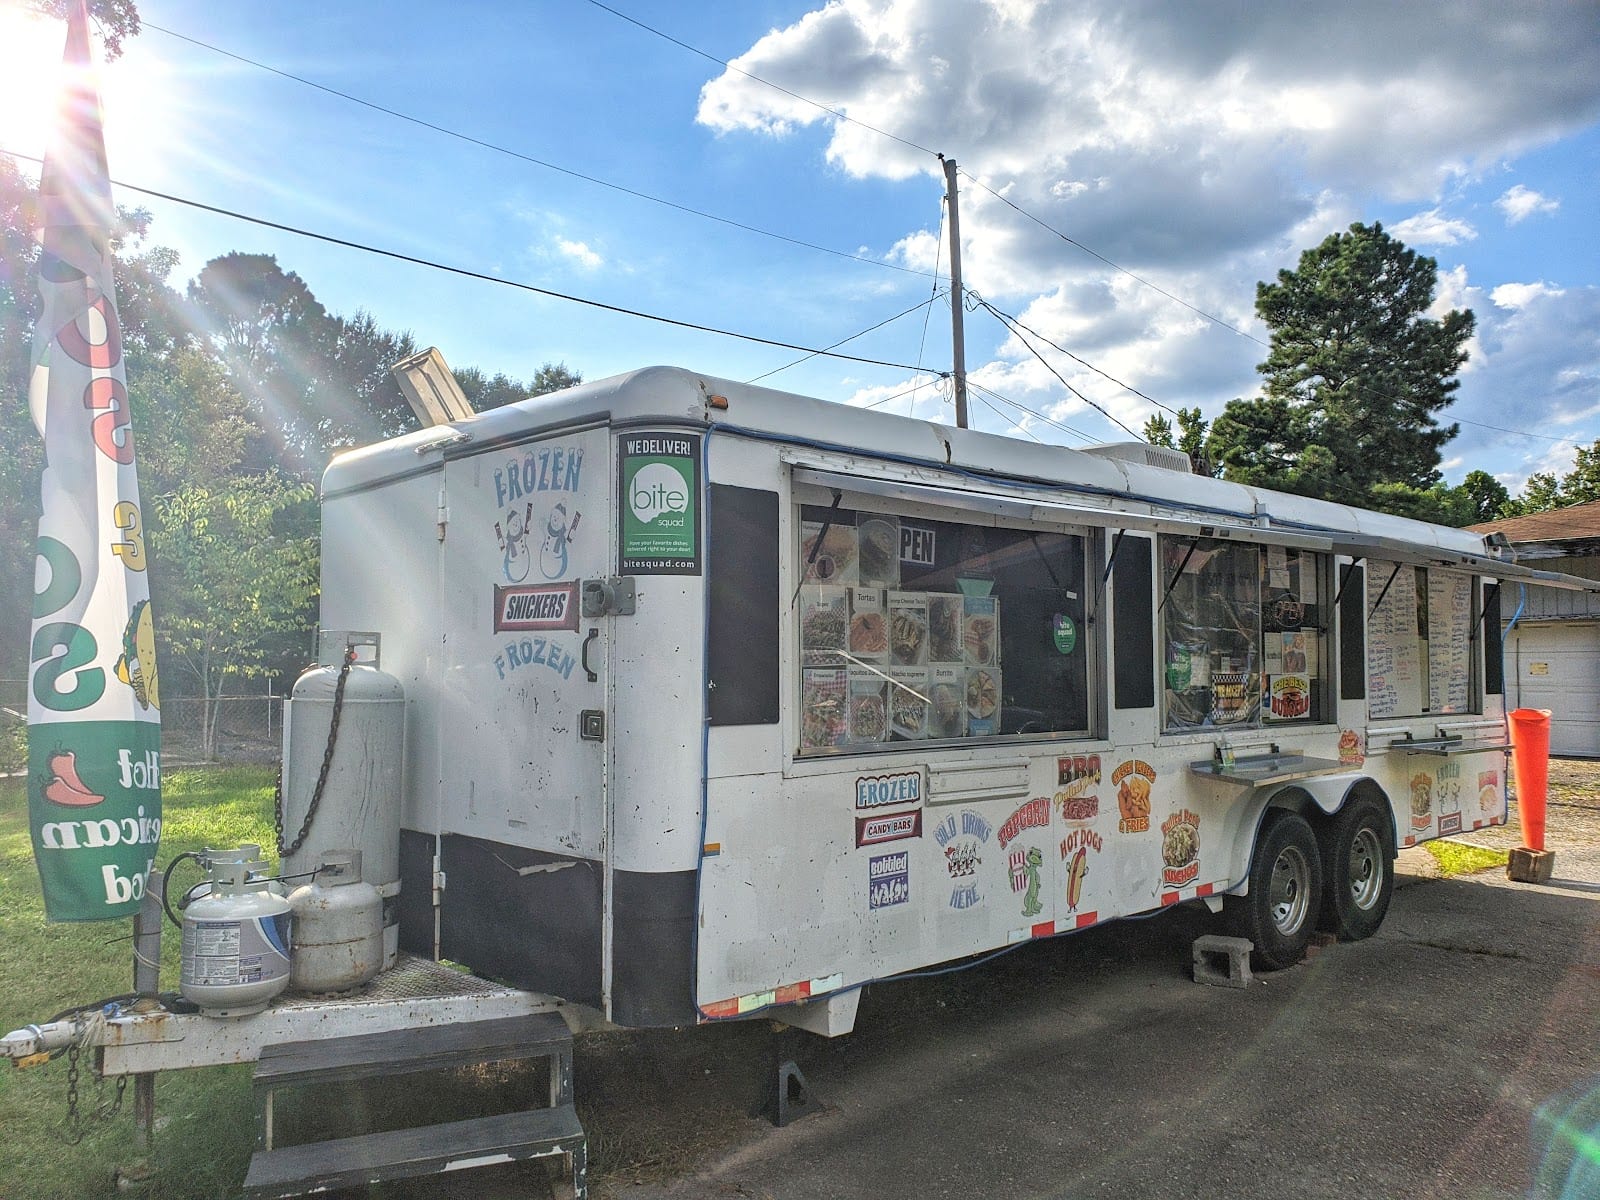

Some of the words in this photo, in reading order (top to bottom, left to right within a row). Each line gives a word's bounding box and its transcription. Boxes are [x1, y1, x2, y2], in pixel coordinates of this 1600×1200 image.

[627, 440, 642, 454] WE
[643, 440, 691, 455] DELIVER!
[494, 447, 584, 508] FROZEN
[633, 477, 685, 510] bite
[658, 517, 684, 529] squad
[900, 527, 934, 564] PEN
[623, 560, 695, 569] bitesquad.com
[506, 592, 567, 620] SNICKERS
[857, 593, 876, 602] Tortas
[493, 636, 577, 681] FROZEN
[1058, 755, 1101, 786] BBQ
[859, 777, 919, 806] FROZEN
[868, 823, 892, 836] CANDY
[893, 819, 911, 832] BARS
[934, 812, 957, 848] COLD
[961, 809, 992, 844] DRINKS
[997, 797, 1051, 850] POPCORN
[1060, 830, 1080, 861] HOT
[1080, 829, 1103, 854] DOGS
[950, 883, 981, 909] HERE
